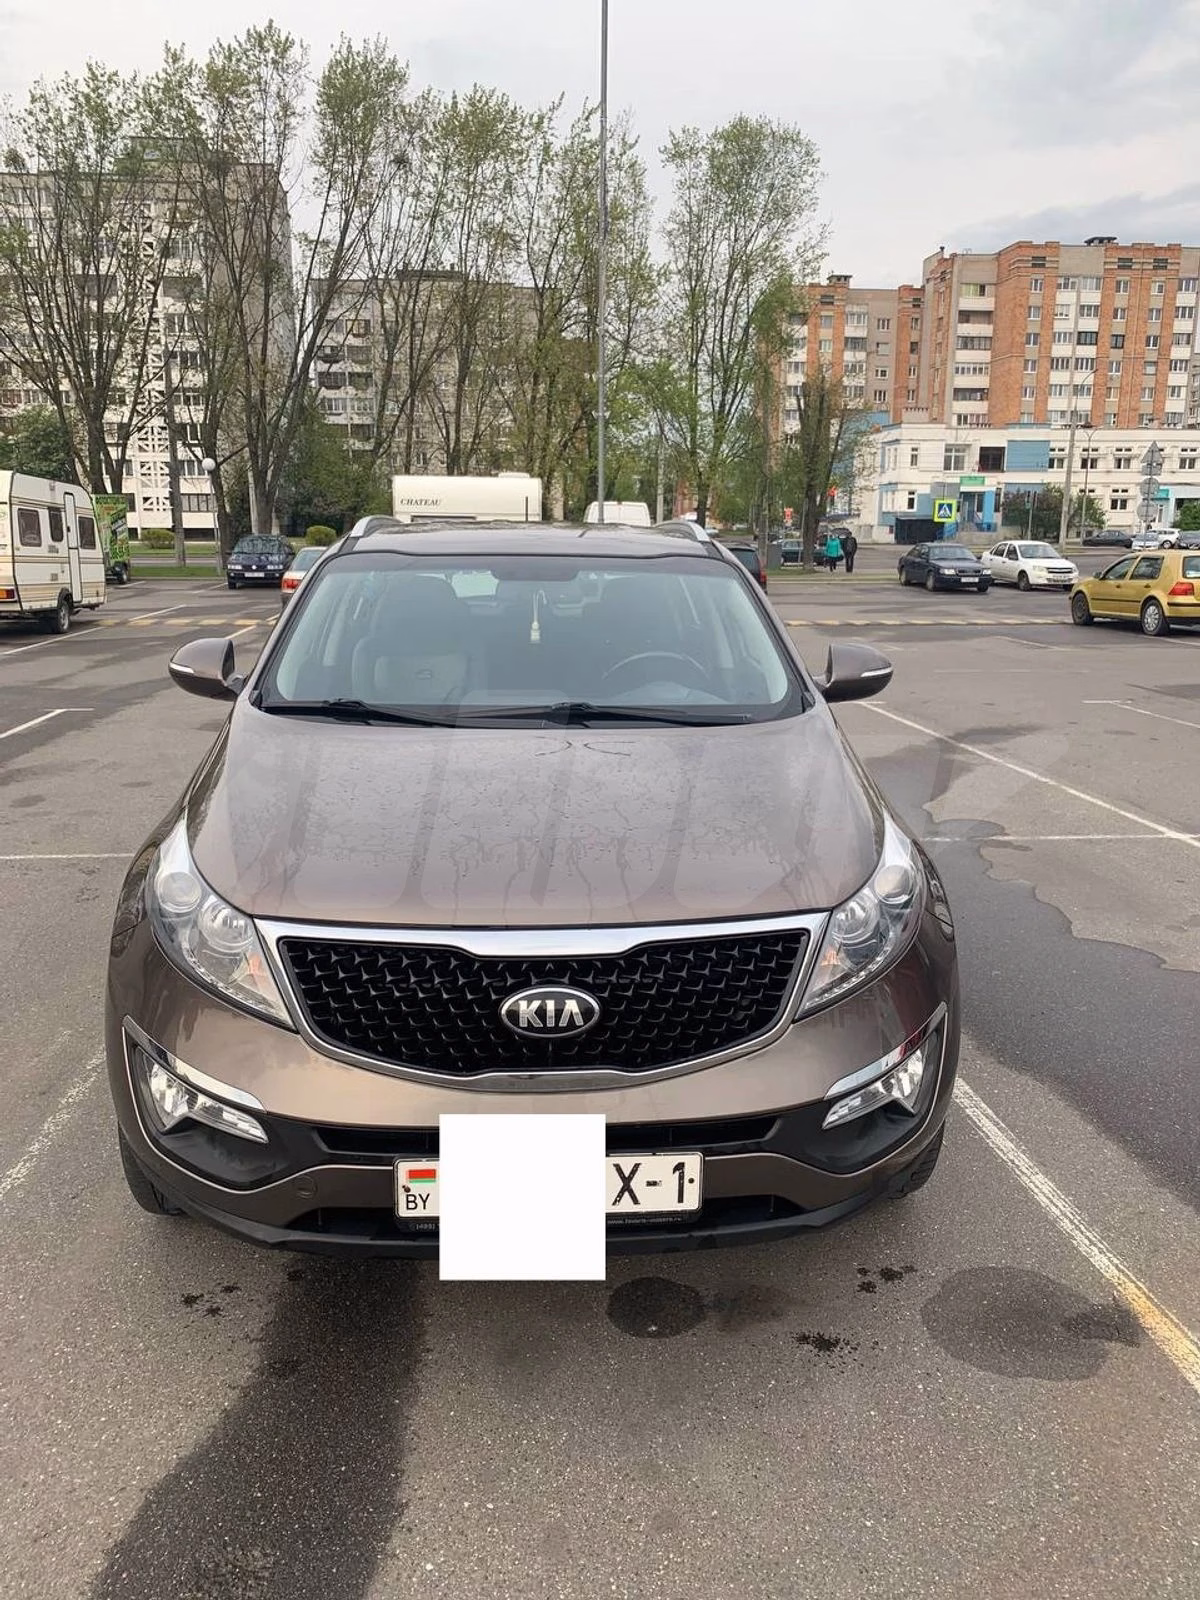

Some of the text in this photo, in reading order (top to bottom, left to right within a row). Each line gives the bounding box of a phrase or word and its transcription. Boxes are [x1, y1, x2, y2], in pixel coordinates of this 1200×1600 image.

[400, 498, 441, 506] CHATEAU
[518, 999, 584, 1028] KIA
[406, 1193, 430, 1210] BY
